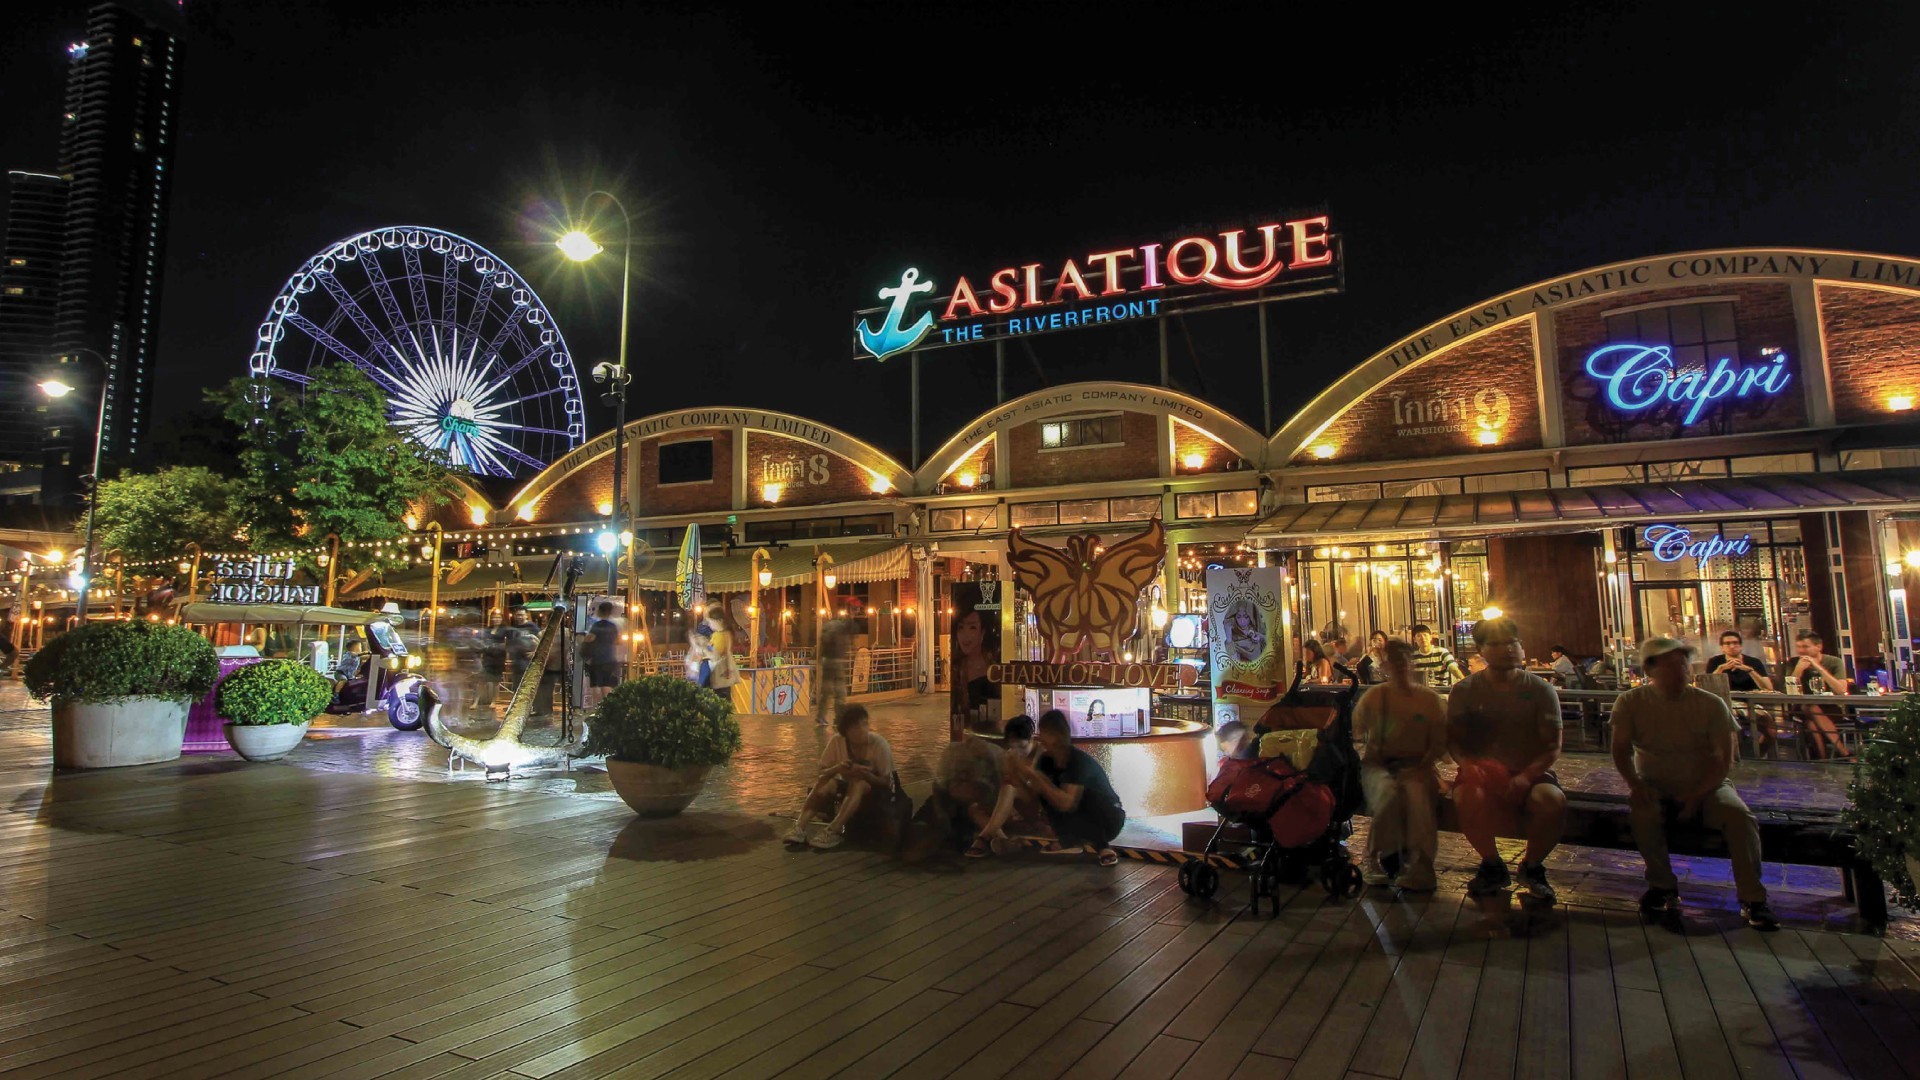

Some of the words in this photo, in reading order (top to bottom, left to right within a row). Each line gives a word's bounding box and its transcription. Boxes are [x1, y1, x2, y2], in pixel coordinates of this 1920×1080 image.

[940, 216, 1333, 320] ASIATIQUE
[942, 323, 985, 344] THE
[1009, 298, 1161, 336] RIVERFRONT
[1385, 333, 1439, 369] THE
[1450, 299, 1515, 338] EAST
[1531, 265, 1651, 309] ASIATIC
[1668, 255, 1829, 276] COMPANY
[1850, 260, 1920, 286] LIM
[1585, 344, 1792, 425] Capri
[961, 427, 984, 446] THE
[986, 409, 1018, 428] EAST
[1024, 394, 1073, 413] ASIATIC
[1082, 391, 1147, 404] COMPANY
[1152, 396, 1204, 420] LIMITED
[1397, 424, 1468, 437] WAREHOUSE
[1473, 387, 1511, 431] 9
[562, 451, 582, 472] THE
[586, 435, 616, 457] EAST
[623, 416, 674, 440] ASIATIC
[681, 411, 751, 426] COMPANY
[761, 415, 831, 445] LIMITED
[808, 453, 830, 485] 8
[1643, 523, 1752, 569] Capri
[986, 663, 1063, 684] CHARM
[1068, 663, 1103, 684] OF
